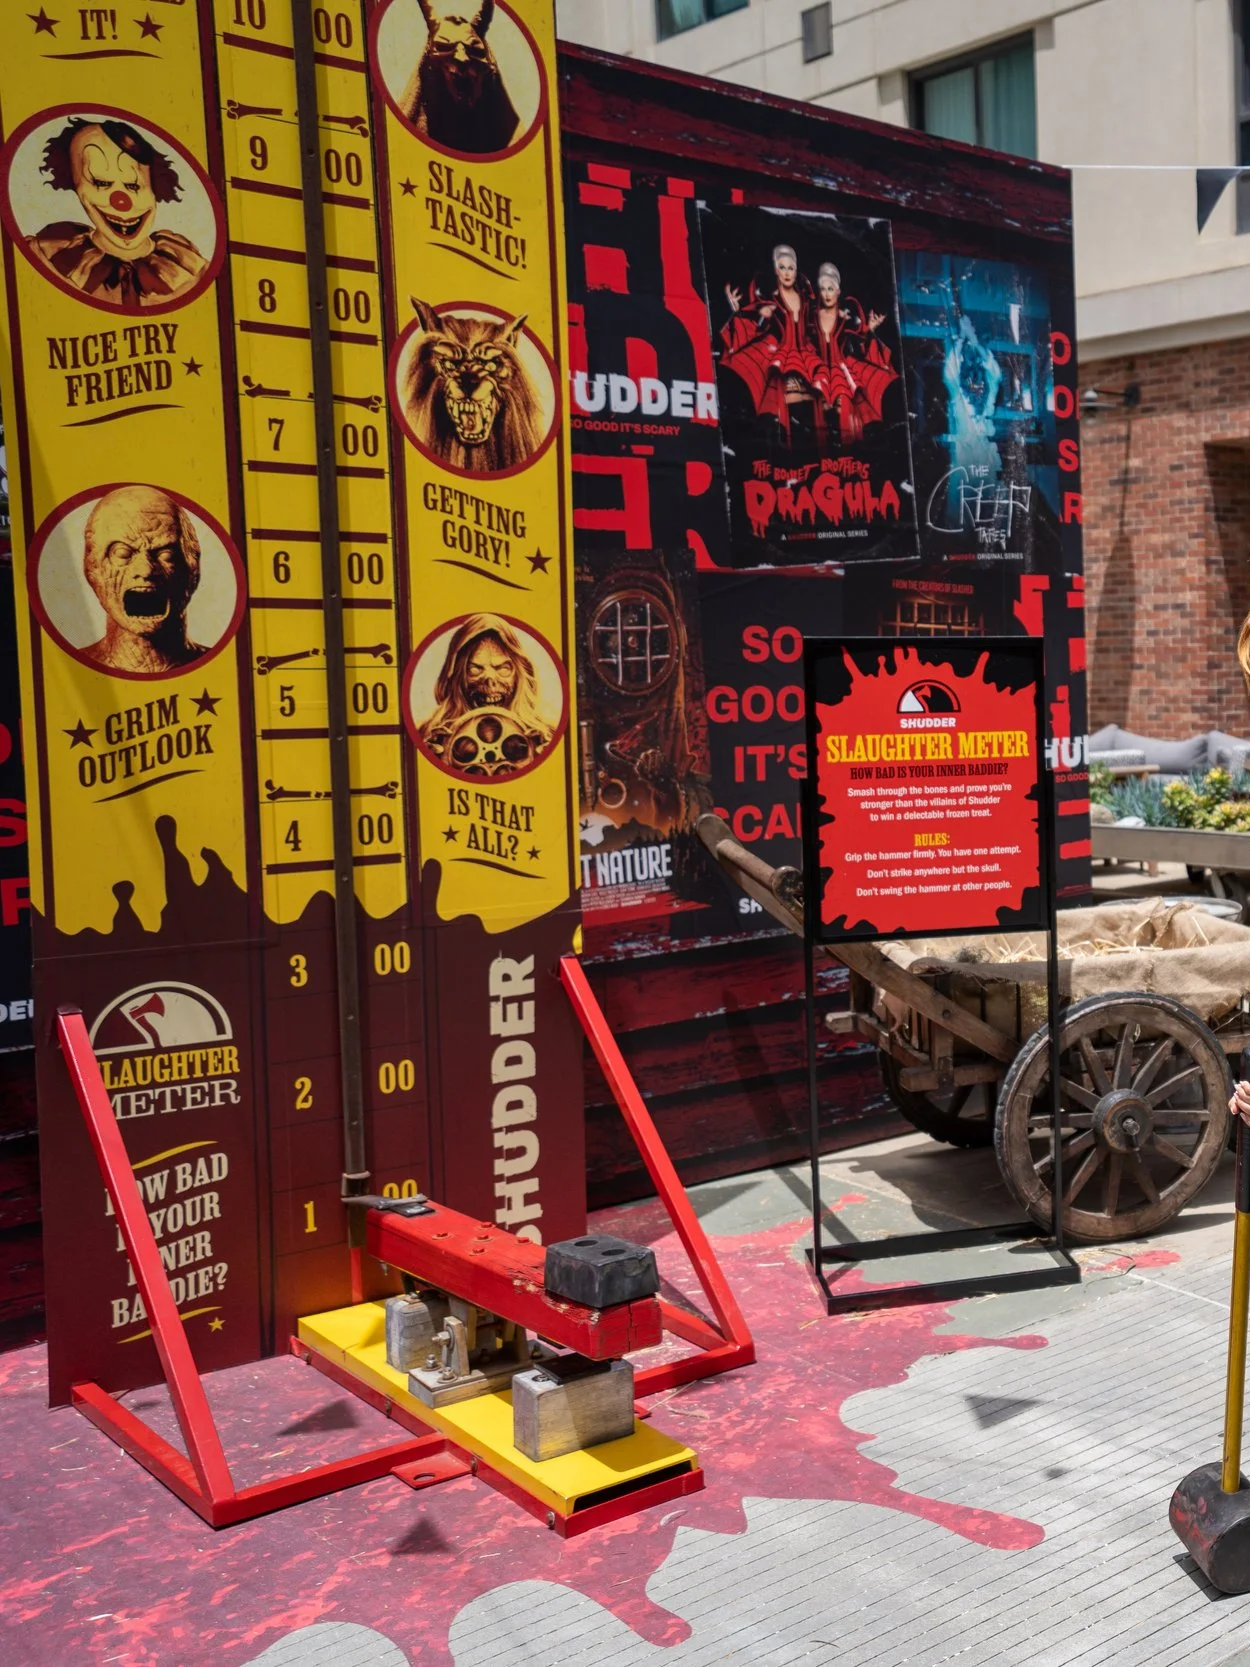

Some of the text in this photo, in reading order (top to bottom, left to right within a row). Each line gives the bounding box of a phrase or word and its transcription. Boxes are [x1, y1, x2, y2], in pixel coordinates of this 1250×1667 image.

[78, 9, 118, 40] IT!
[233, 0, 352, 48] 10 00
[249, 136, 362, 187] 9 00
[428, 160, 521, 229] SLASH-
[425, 197, 527, 269] TASTIC!
[258, 278, 371, 324] 8 00
[46, 323, 178, 369] NICE TRY
[65, 359, 172, 407] FRIEND
[569, 370, 718, 419] UDDER
[268, 418, 378, 457] 7 00
[584, 421, 619, 432] GOOD
[643, 424, 680, 436] SCARY
[752, 460, 772, 479] THE
[821, 457, 870, 479] BROTHERS
[968, 464, 990, 477] THE
[423, 482, 527, 538] GETTING
[744, 472, 900, 539] DRAGULA
[442, 519, 511, 568] GORY!
[818, 531, 846, 539] ORIGINAL
[848, 529, 868, 537] SERIES
[975, 527, 1006, 550] TAPES
[273, 551, 384, 584] 6 00
[1004, 552, 1023, 560] SERIES
[742, 625, 804, 663] SO
[105, 693, 180, 745] GRIM
[279, 682, 388, 717] 5 00
[900, 717, 956, 729] SHUDDER
[78, 724, 214, 788] OUTLOOK
[734, 743, 808, 783] IT'S
[826, 731, 1030, 763] SLAUGHTER METER
[848, 784, 1011, 797] Smash through the bones and prove you're
[850, 763, 1009, 780] HOW BAD IS YOUR INNER BADDIE?
[448, 788, 535, 832] IS THAT
[713, 802, 803, 842] CA
[861, 796, 1000, 810] stronger than the villains of Shudder
[870, 808, 992, 821] to win a delectable frozen treat.
[285, 813, 393, 851] 4 00
[467, 823, 519, 861] ALL?
[914, 833, 951, 847] RULES:
[597, 844, 672, 886] NATURE
[845, 846, 1021, 862] Grip the hammer firmly. You have one attempt.
[867, 864, 1001, 879] Don't strike anywhere but the skull.
[857, 880, 1012, 896] Don't swing the hammer at other people.
[290, 941, 411, 987] 3 00
[98, 1046, 240, 1089] LAUGHTER
[294, 1059, 415, 1110] 2 00
[175, 1152, 229, 1194] BAD
[149, 1191, 221, 1240] YOUR
[304, 1200, 318, 1233] 1
[111, 1262, 228, 1328] BADIE?
